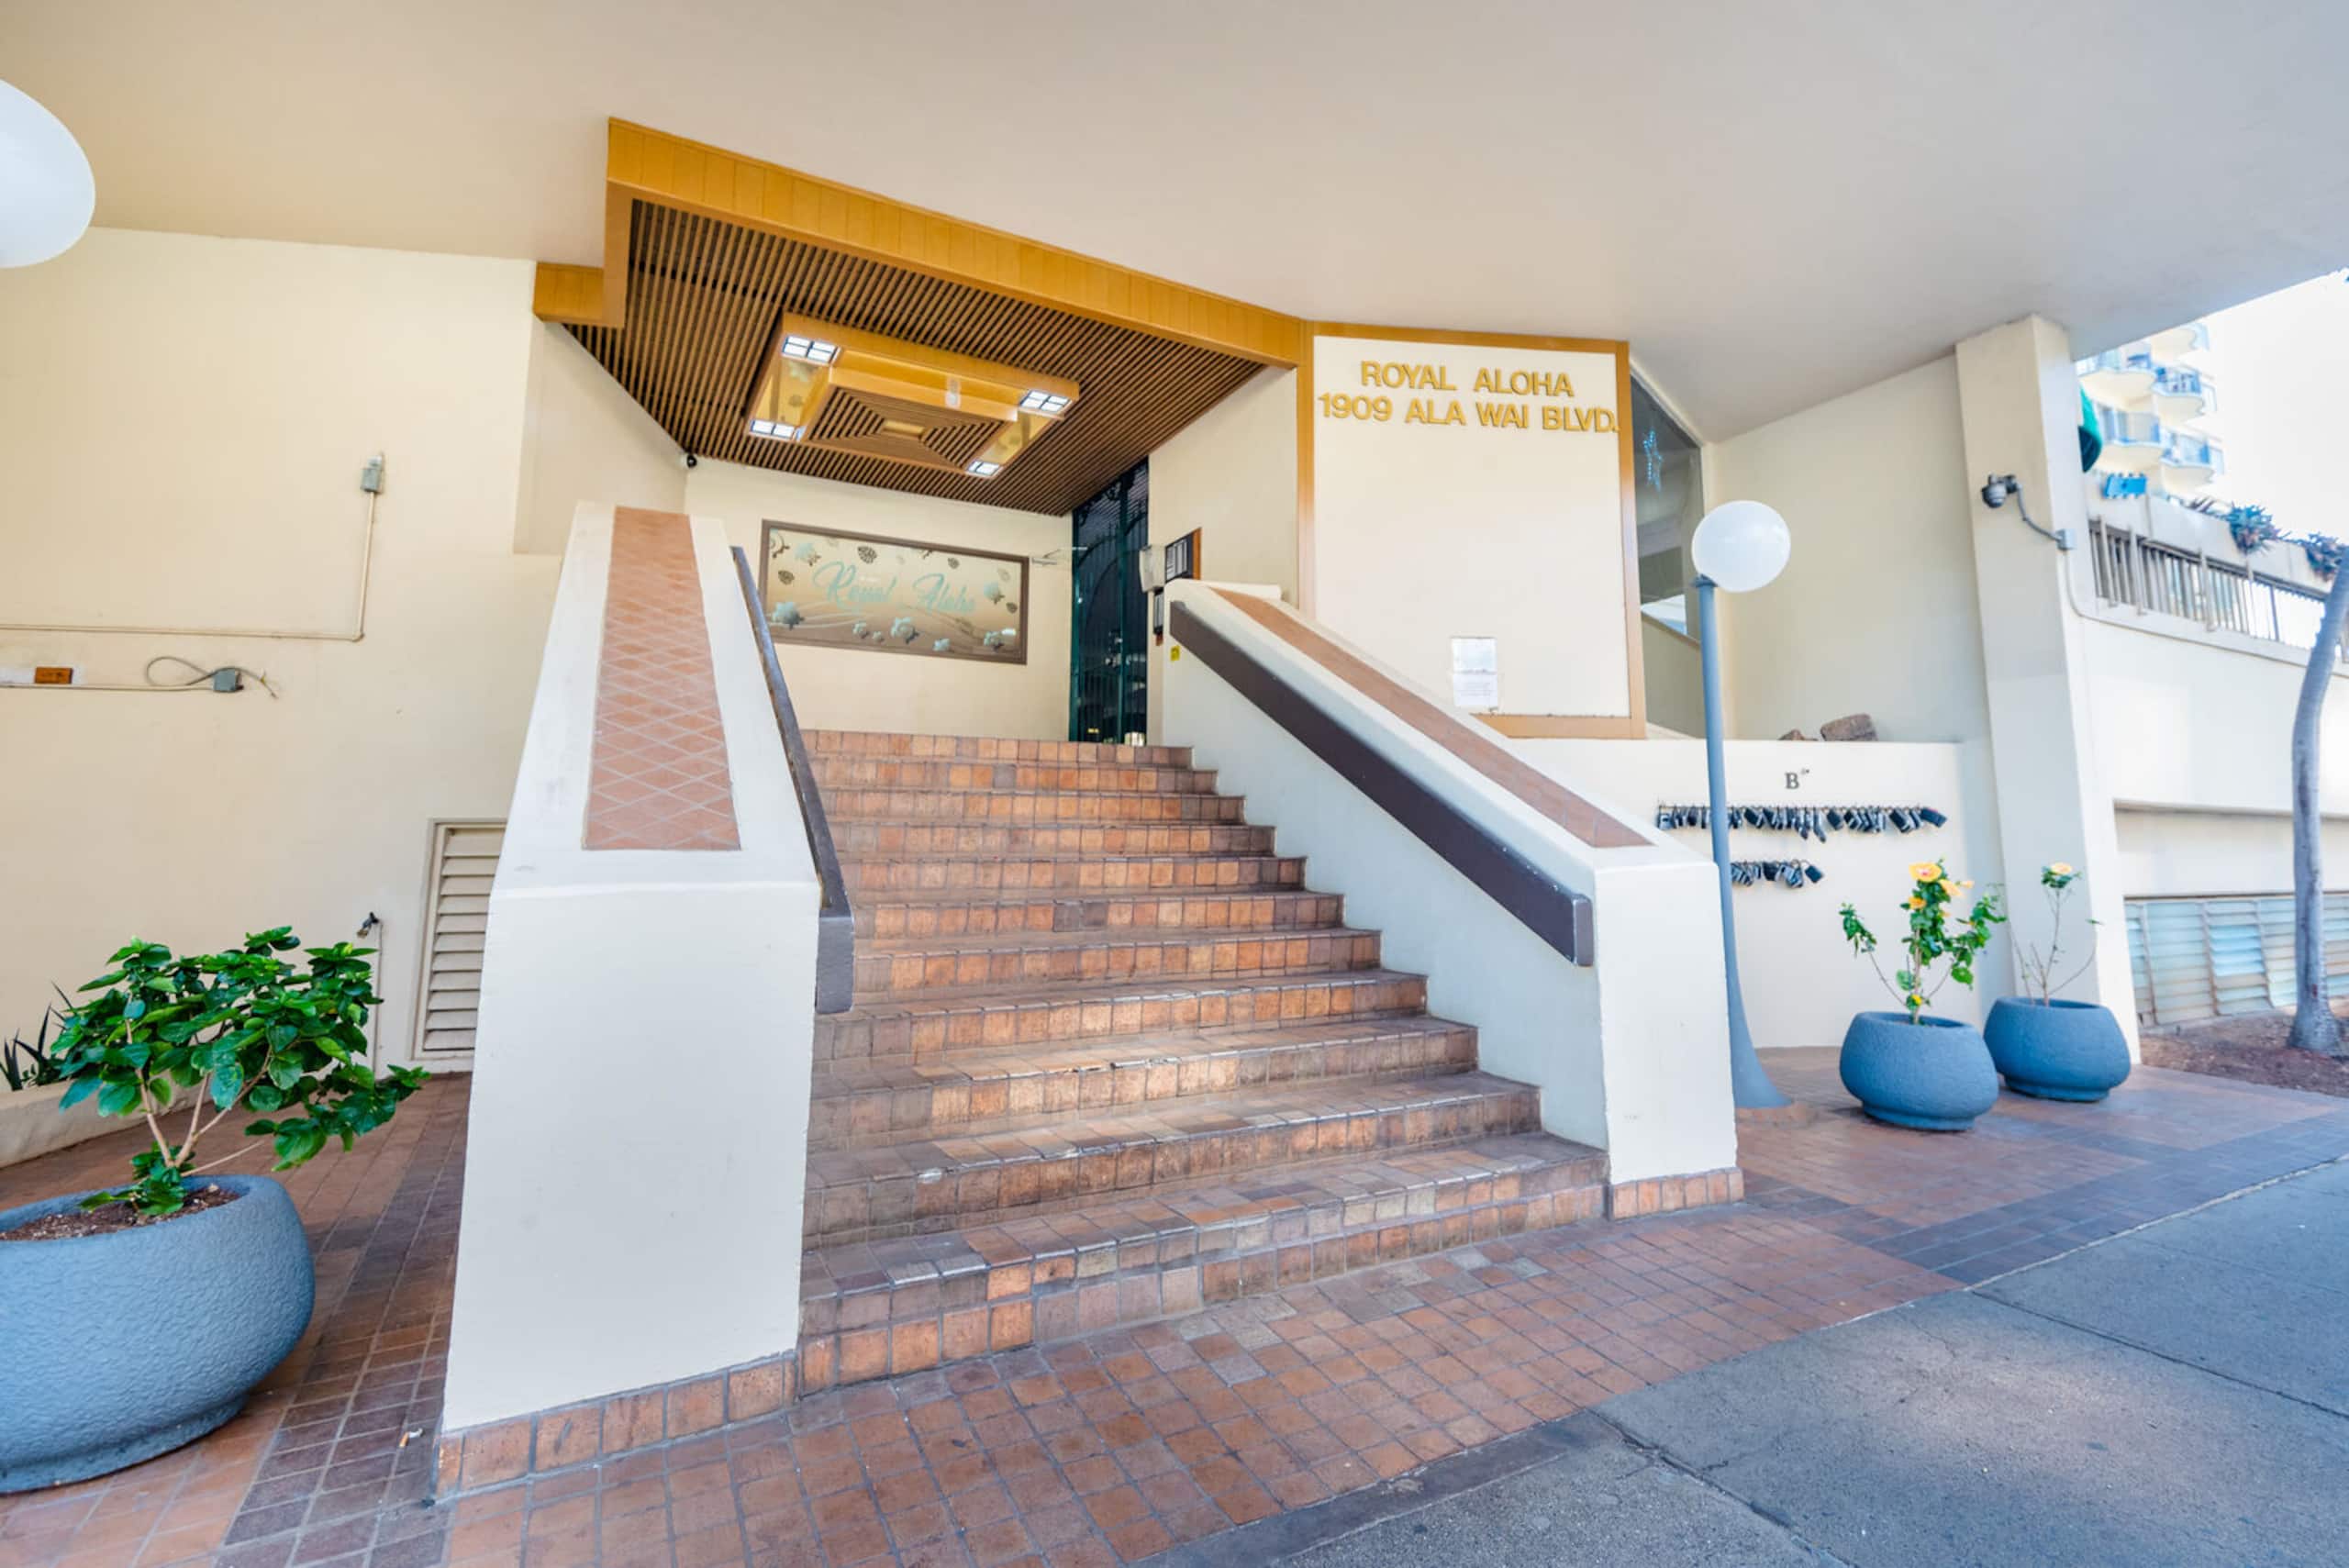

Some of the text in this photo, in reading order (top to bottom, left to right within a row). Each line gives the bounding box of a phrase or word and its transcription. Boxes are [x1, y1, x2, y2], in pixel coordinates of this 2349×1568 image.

[1361, 360, 1575, 397] ROYAL ALOHA
[1318, 392, 1620, 433] 1909 ALA WAI BLVD.
